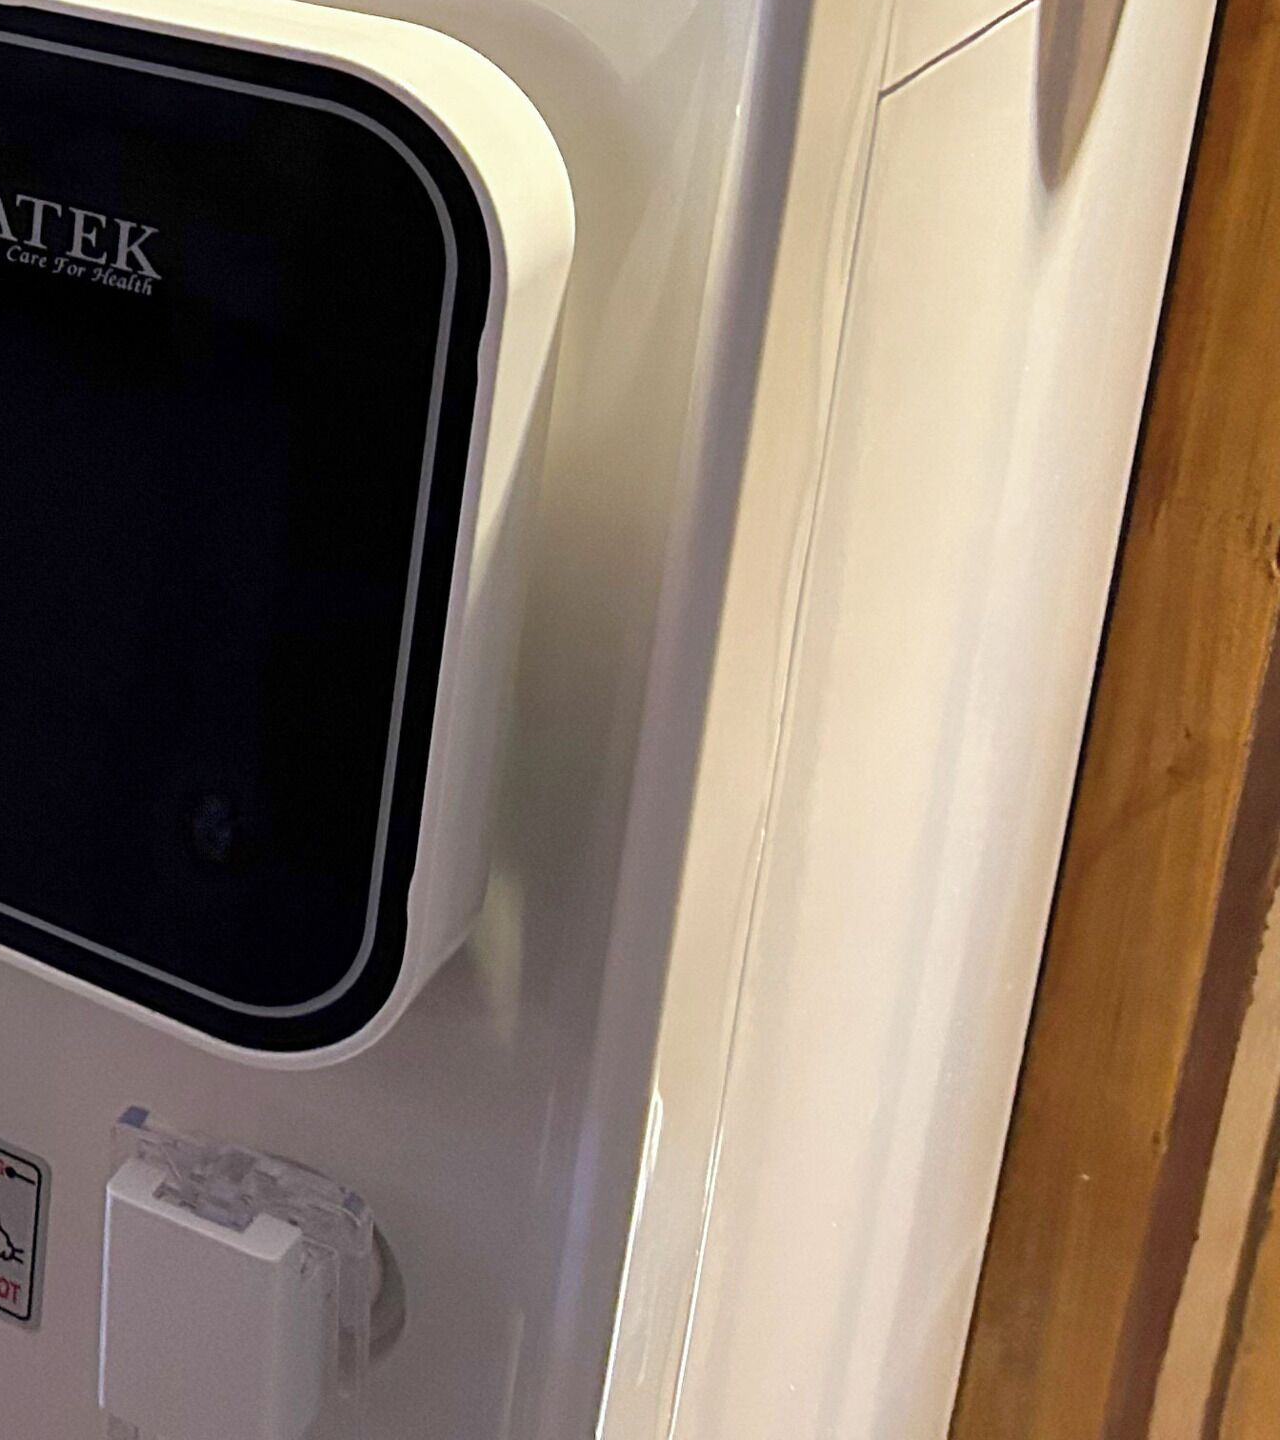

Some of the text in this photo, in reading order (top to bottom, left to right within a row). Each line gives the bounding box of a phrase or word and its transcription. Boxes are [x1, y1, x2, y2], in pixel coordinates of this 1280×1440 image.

[6, 245, 153, 296] Care For Health
